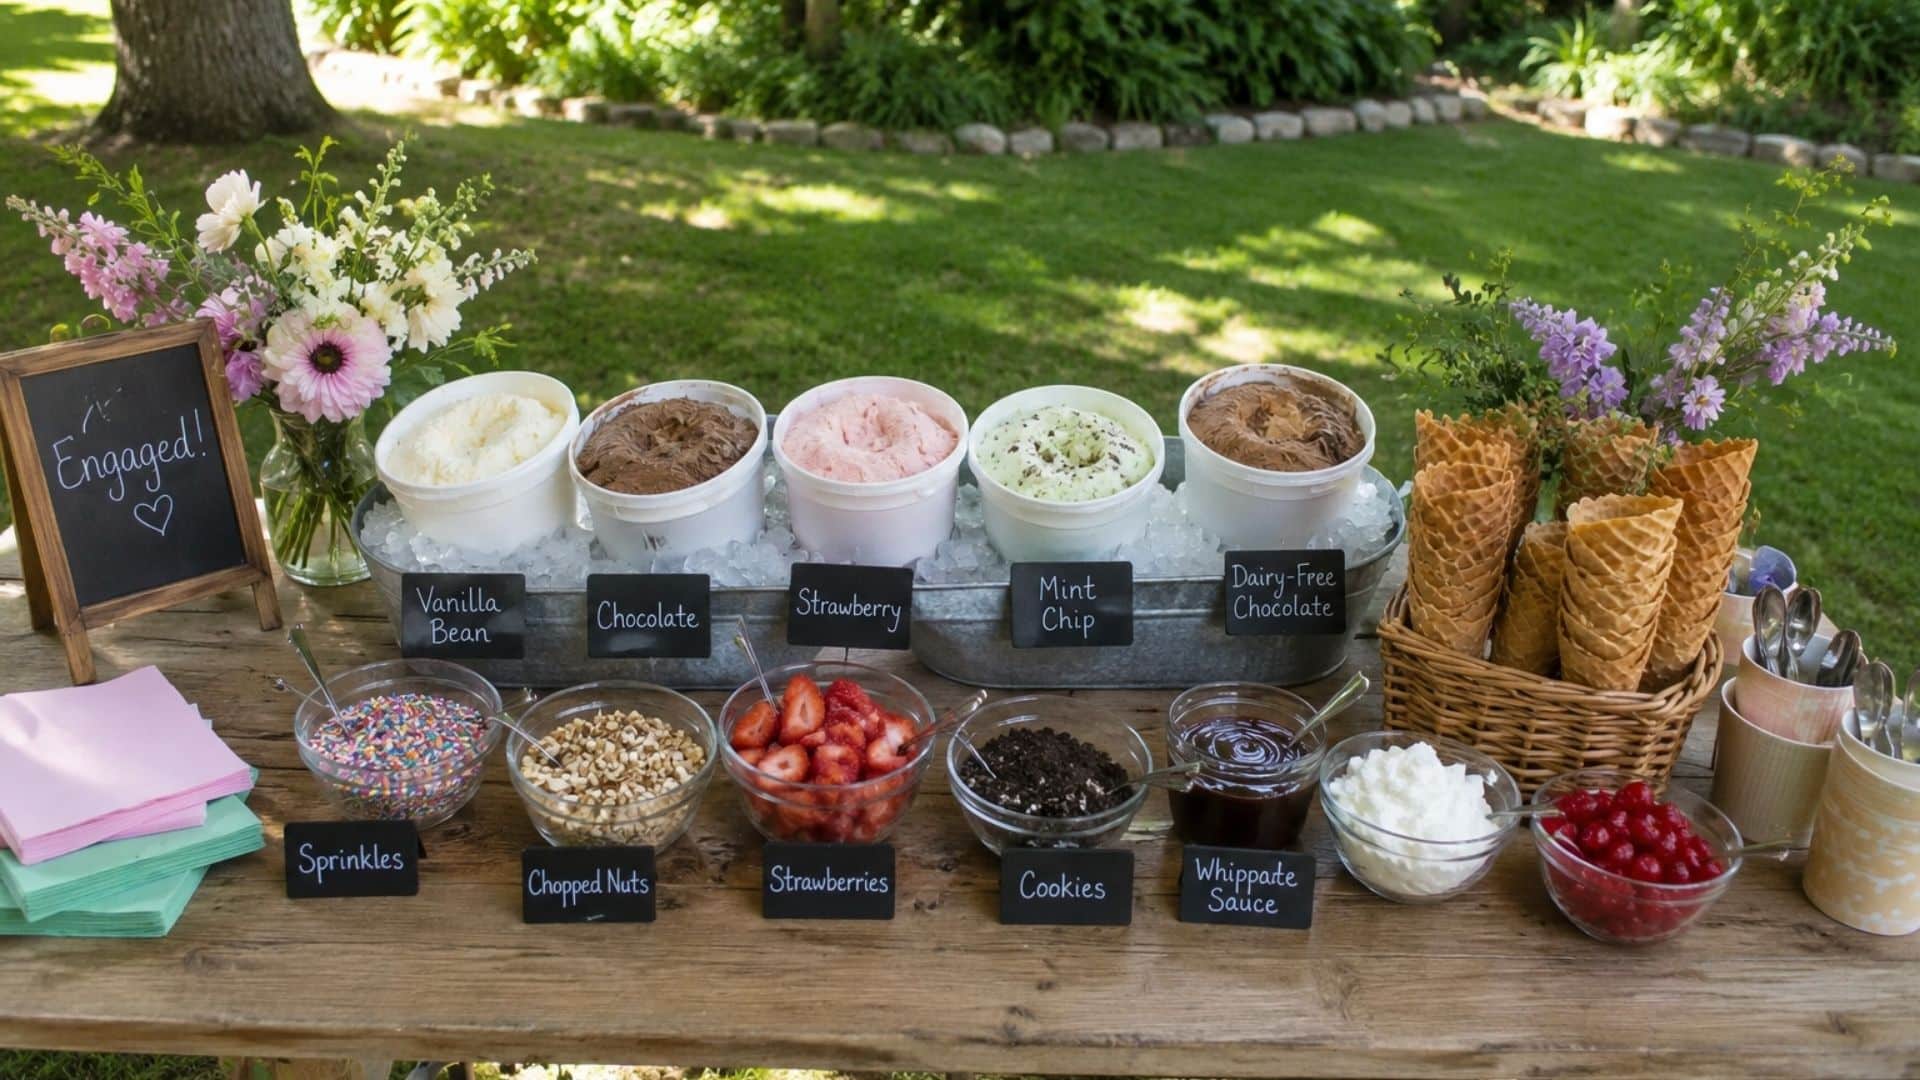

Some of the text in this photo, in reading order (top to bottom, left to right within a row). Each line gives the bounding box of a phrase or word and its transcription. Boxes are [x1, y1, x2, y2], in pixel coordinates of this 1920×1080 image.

[52, 408, 207, 501] Engaged!
[1039, 575, 1097, 601] Mint
[1231, 562, 1336, 599] Dairy-Free
[416, 585, 501, 613] Vanilla
[796, 587, 901, 633] Strawberry
[1233, 594, 1334, 619] Chocolate
[597, 600, 699, 630] Chocolate
[1042, 606, 1095, 639] Chip
[430, 619, 490, 644] Bean
[299, 843, 404, 884] Sprinkles
[528, 868, 649, 908] Chopped Nuts
[770, 865, 889, 893] Strawberries
[1020, 870, 1106, 899] Cookies
[1208, 887, 1278, 914] Sauce
